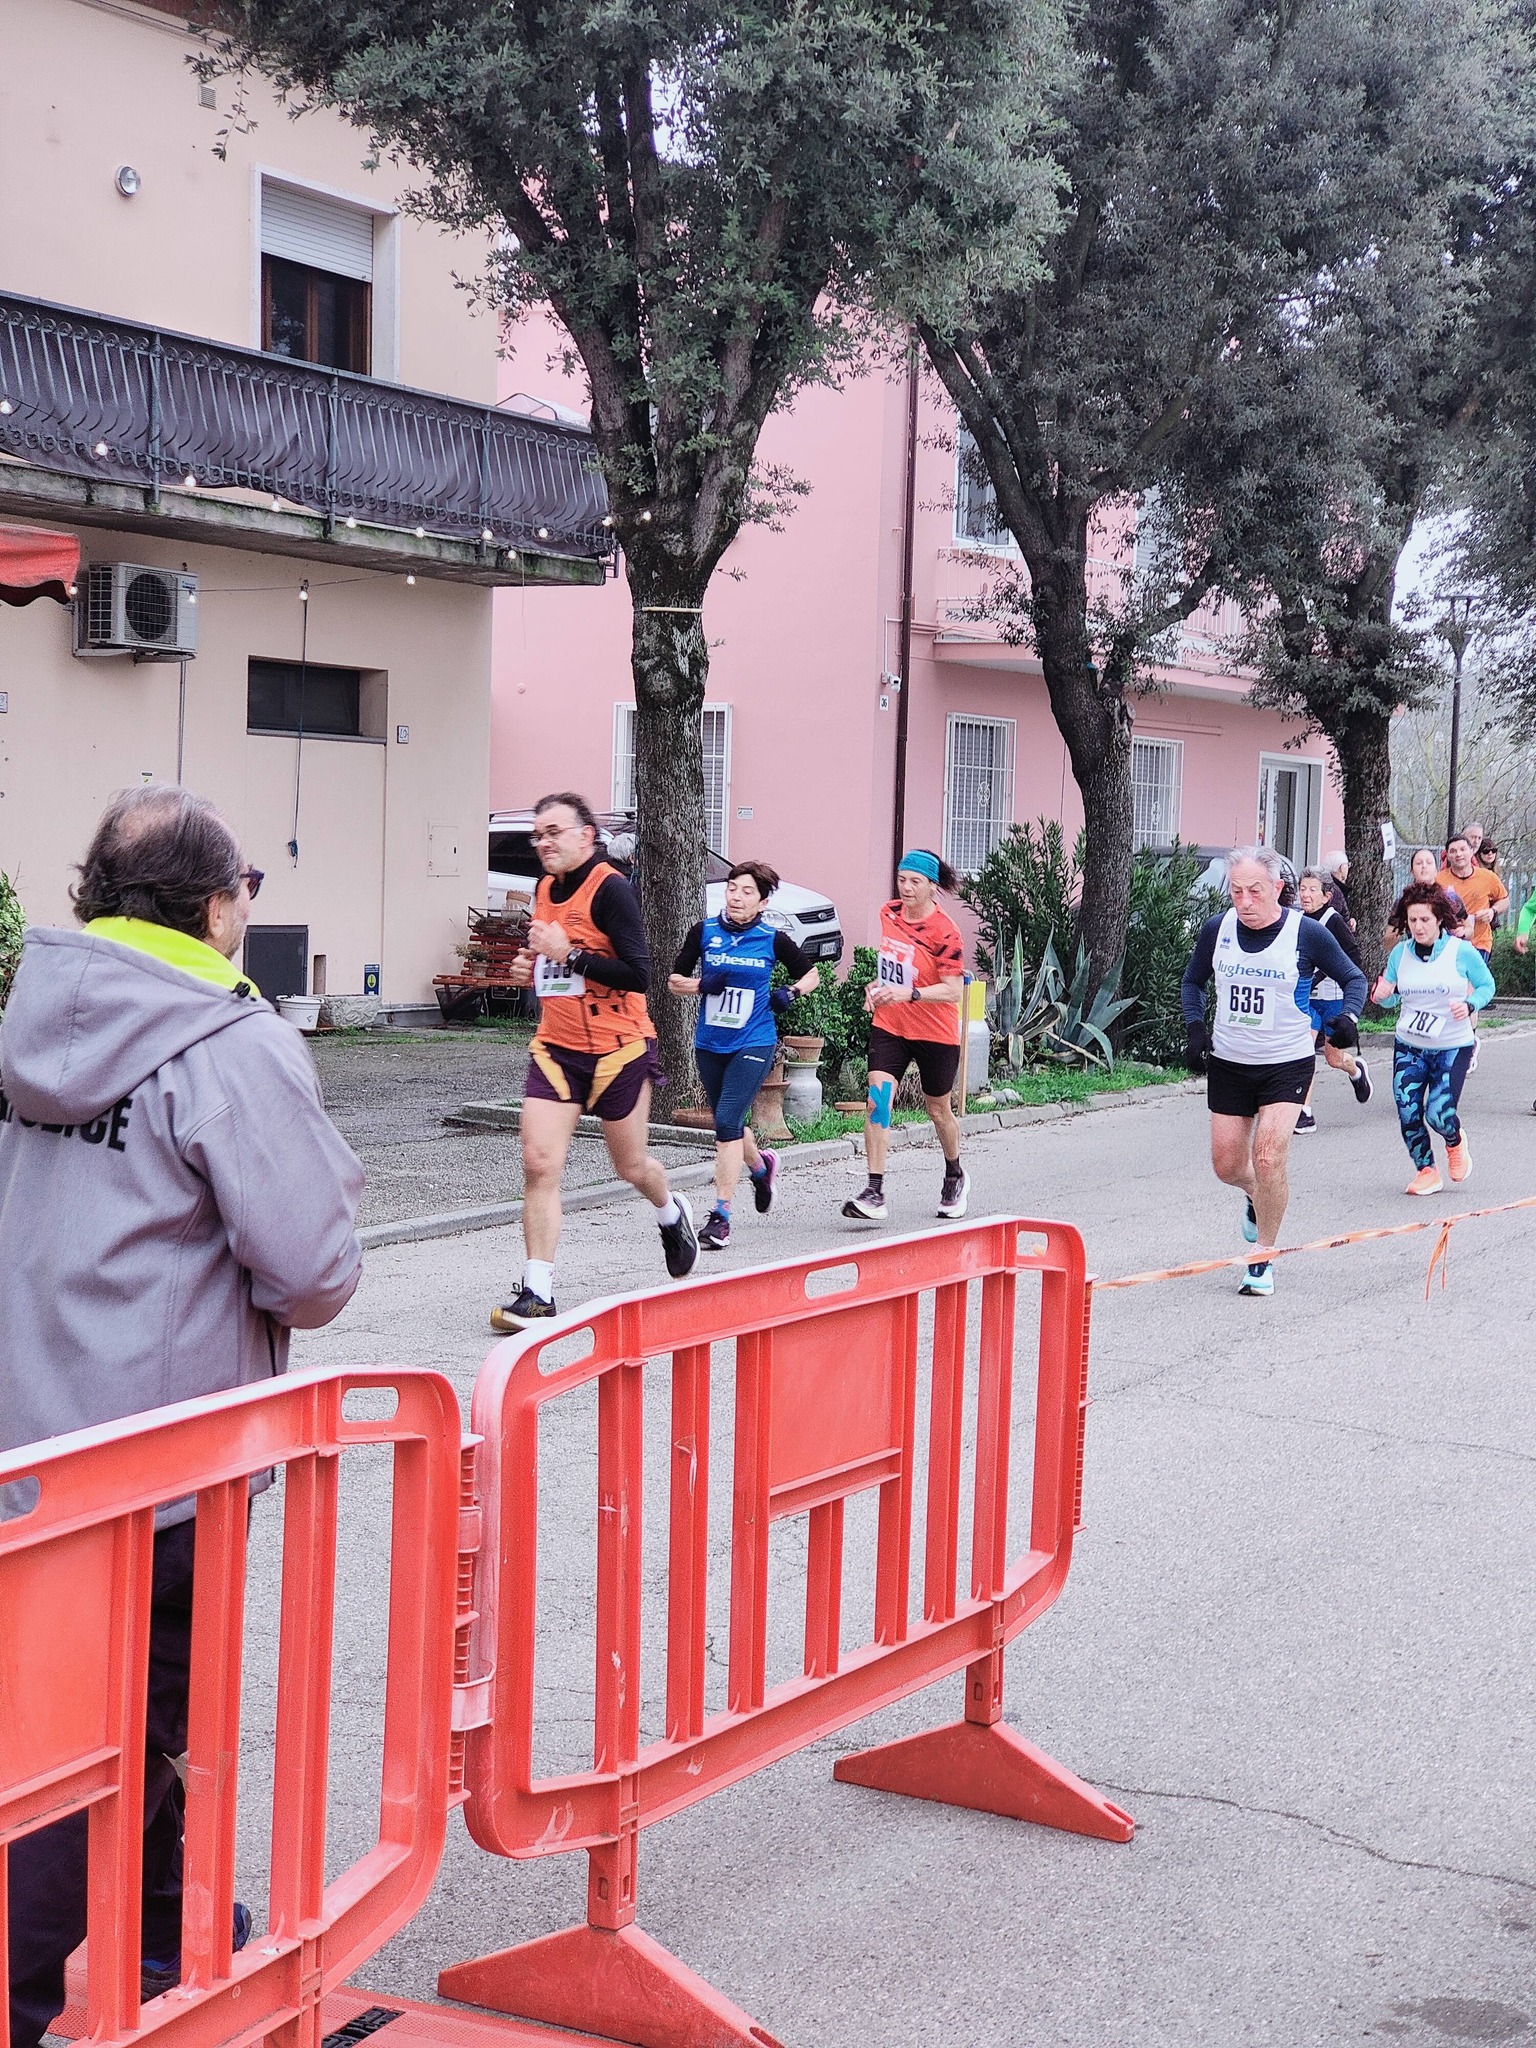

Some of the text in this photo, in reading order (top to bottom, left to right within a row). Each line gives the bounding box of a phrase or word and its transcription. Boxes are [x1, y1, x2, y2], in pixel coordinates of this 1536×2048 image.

[881, 958, 904, 985] 629
[1217, 960, 1286, 980] lughesina
[1229, 985, 1265, 1015] 635
[1408, 1010, 1438, 1033] 787
